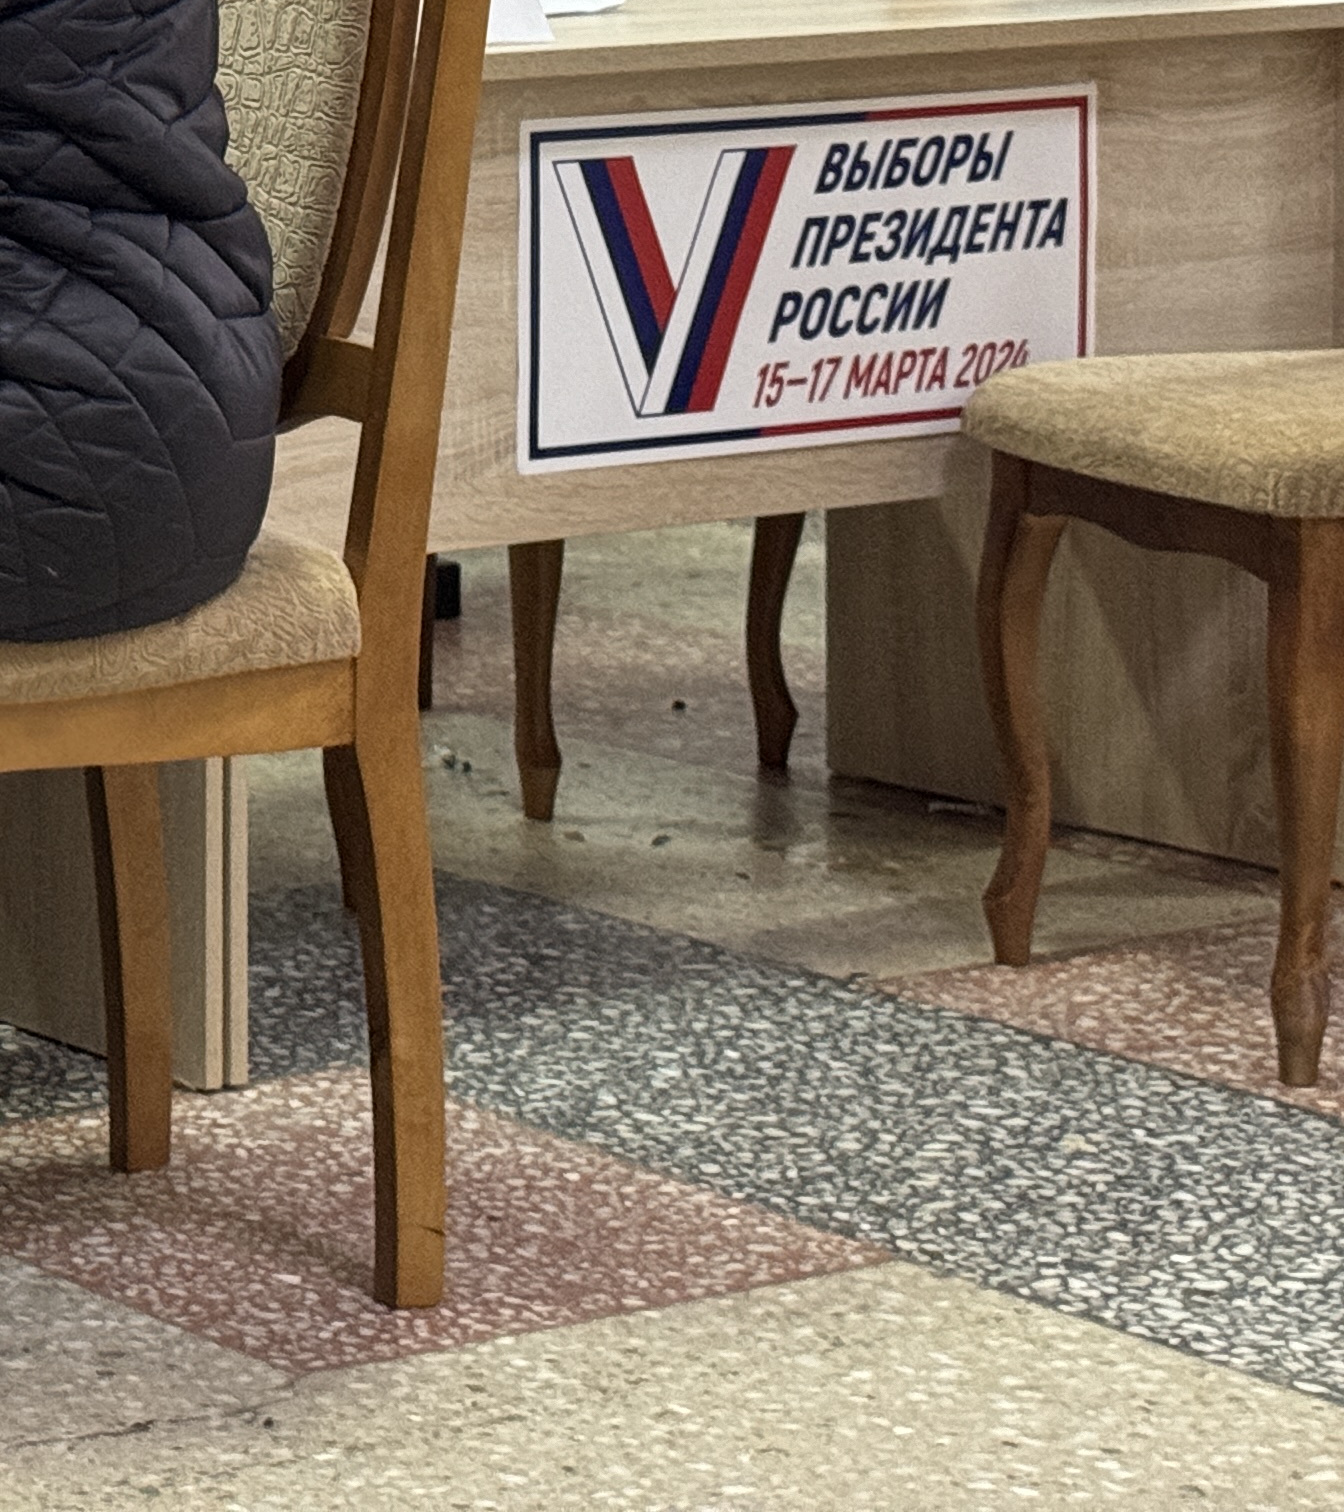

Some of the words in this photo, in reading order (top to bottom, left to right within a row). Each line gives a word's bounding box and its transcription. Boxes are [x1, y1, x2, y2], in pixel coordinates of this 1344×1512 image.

[813, 130, 1014, 195] ВЫБОРЫ
[789, 197, 1069, 269] ПРЕЗИДЕНТА
[767, 277, 951, 344] РОССИИ
[842, 345, 951, 401] МАРТА
